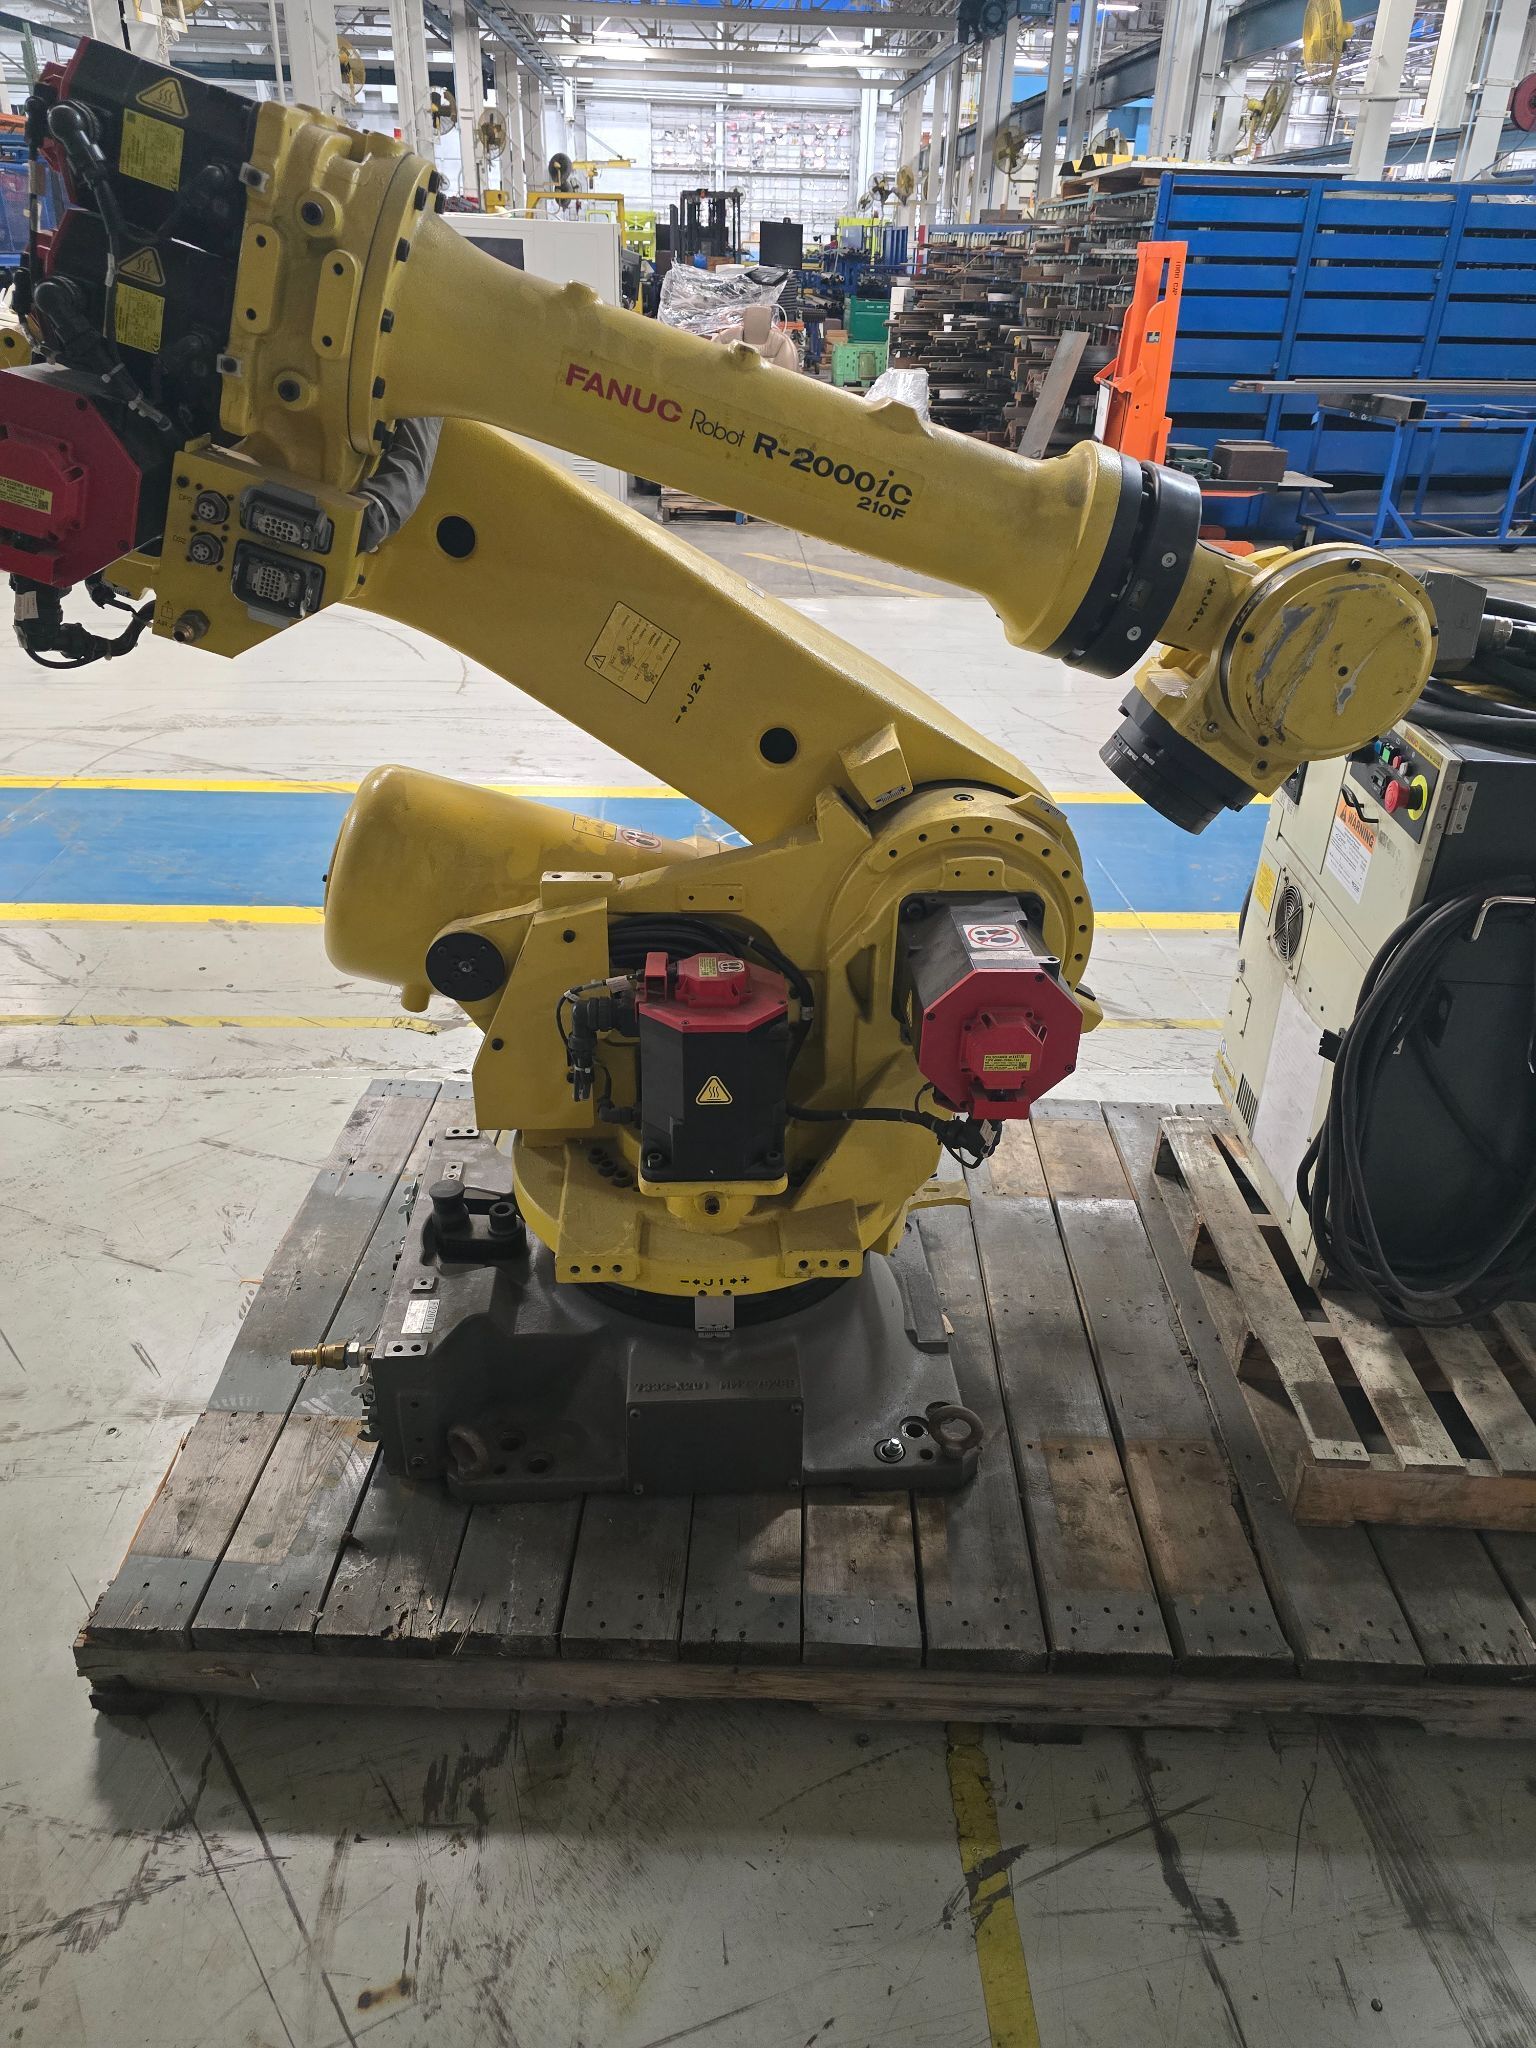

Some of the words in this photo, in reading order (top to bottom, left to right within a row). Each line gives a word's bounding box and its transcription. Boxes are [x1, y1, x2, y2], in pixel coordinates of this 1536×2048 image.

[565, 363, 683, 423] FANUC
[690, 409, 747, 447] Robot
[753, 432, 914, 506] R-2000iC
[856, 496, 907, 521] 210F
[1347, 813, 1375, 849] WARNING
